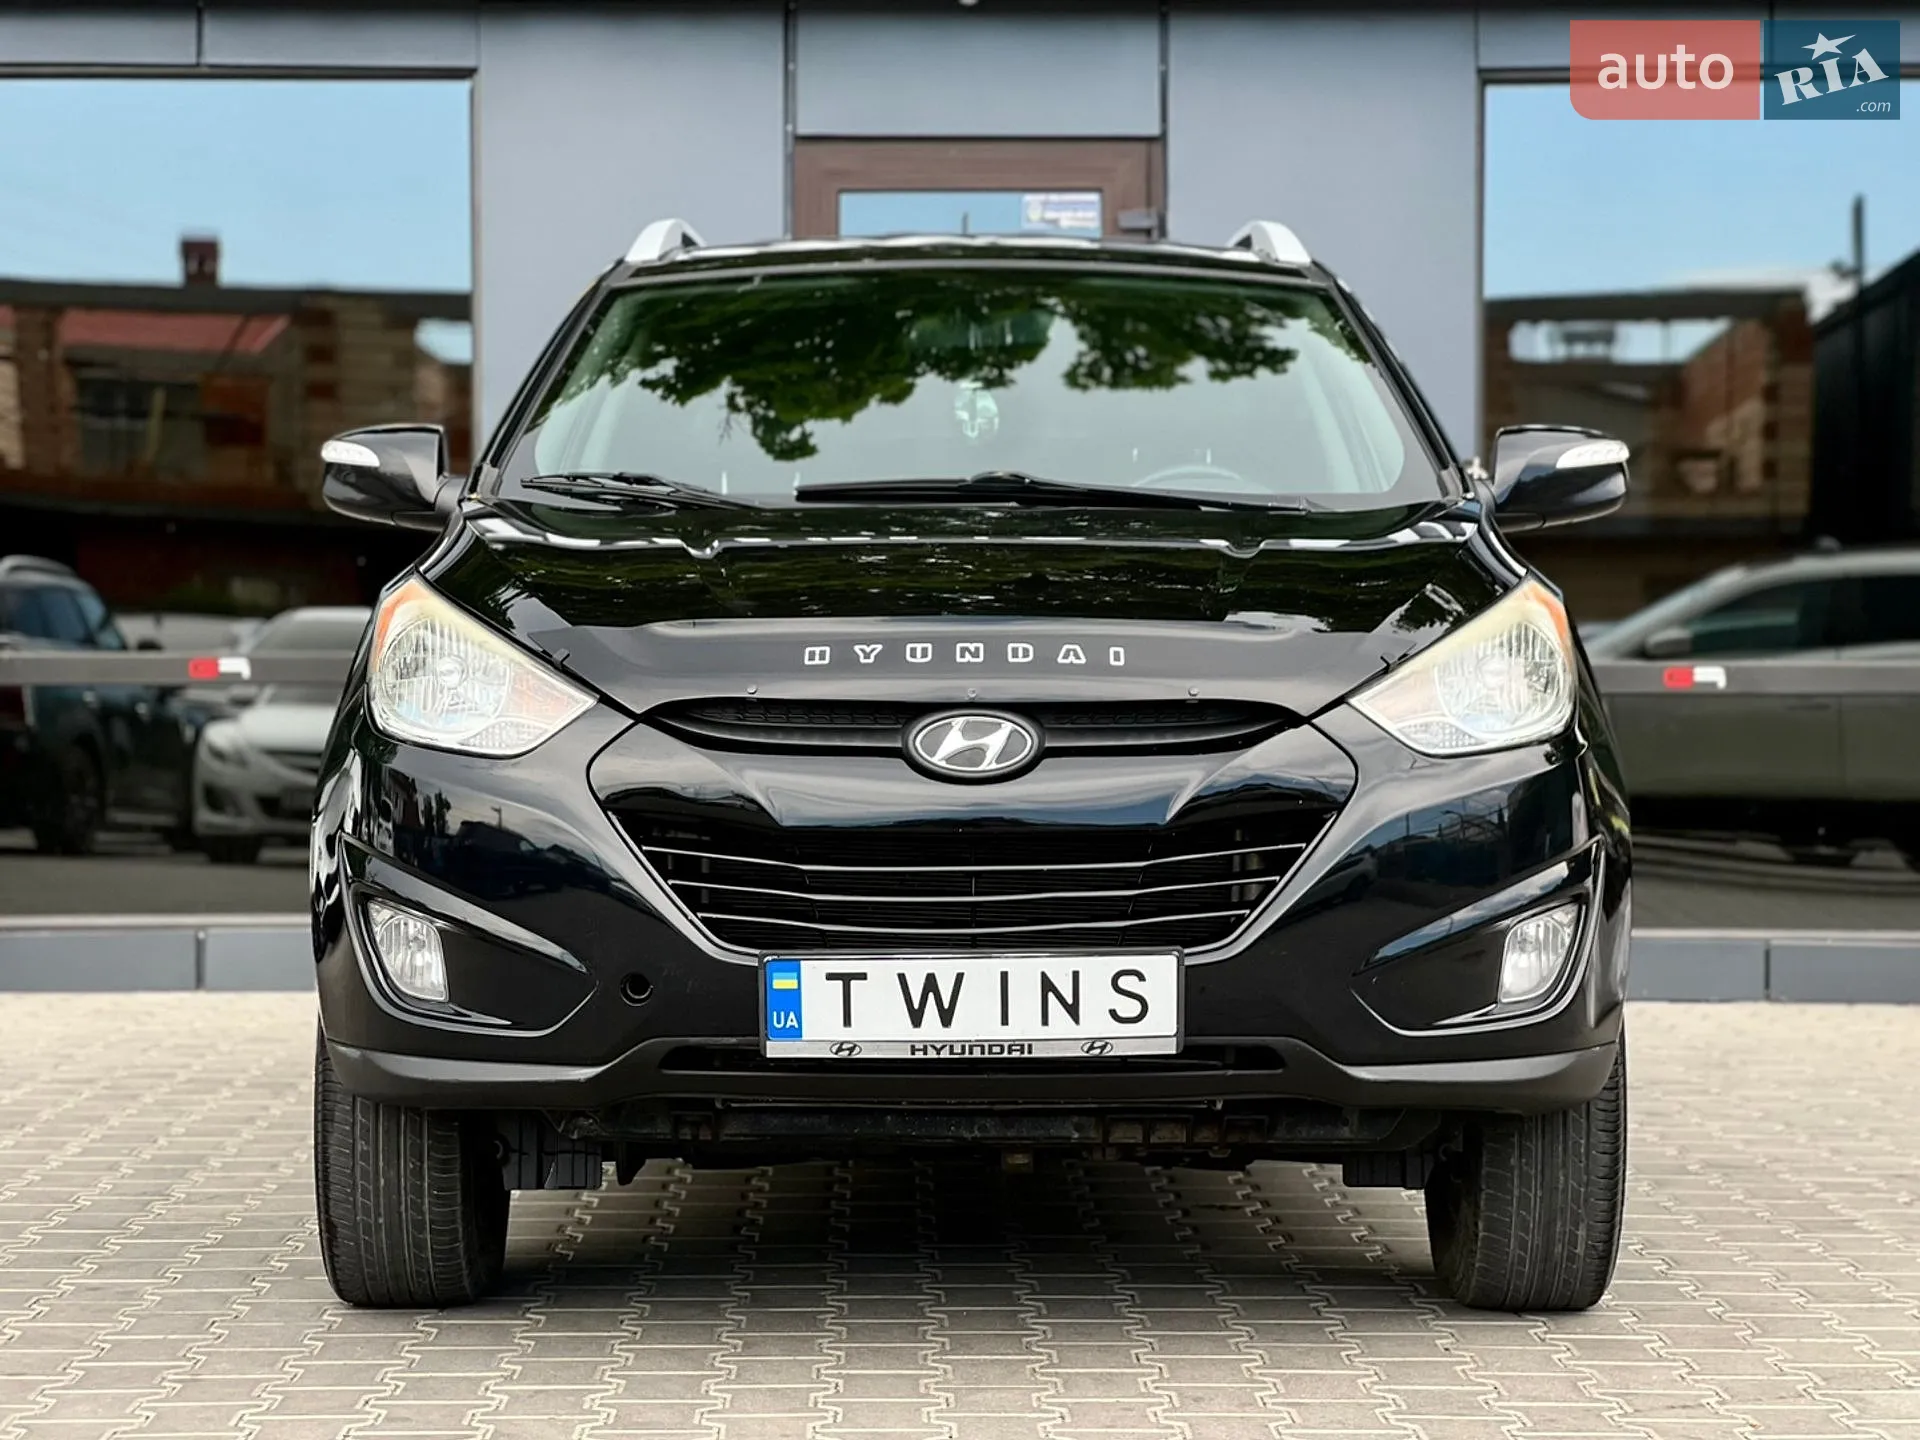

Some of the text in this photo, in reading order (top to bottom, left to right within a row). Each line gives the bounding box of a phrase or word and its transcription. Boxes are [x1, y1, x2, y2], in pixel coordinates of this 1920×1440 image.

[804, 643, 1125, 666] HYUNDAI
[825, 969, 1149, 1028] TWINS
[772, 1011, 799, 1029] UA
[910, 1043, 1033, 1056] HYUNDAI
